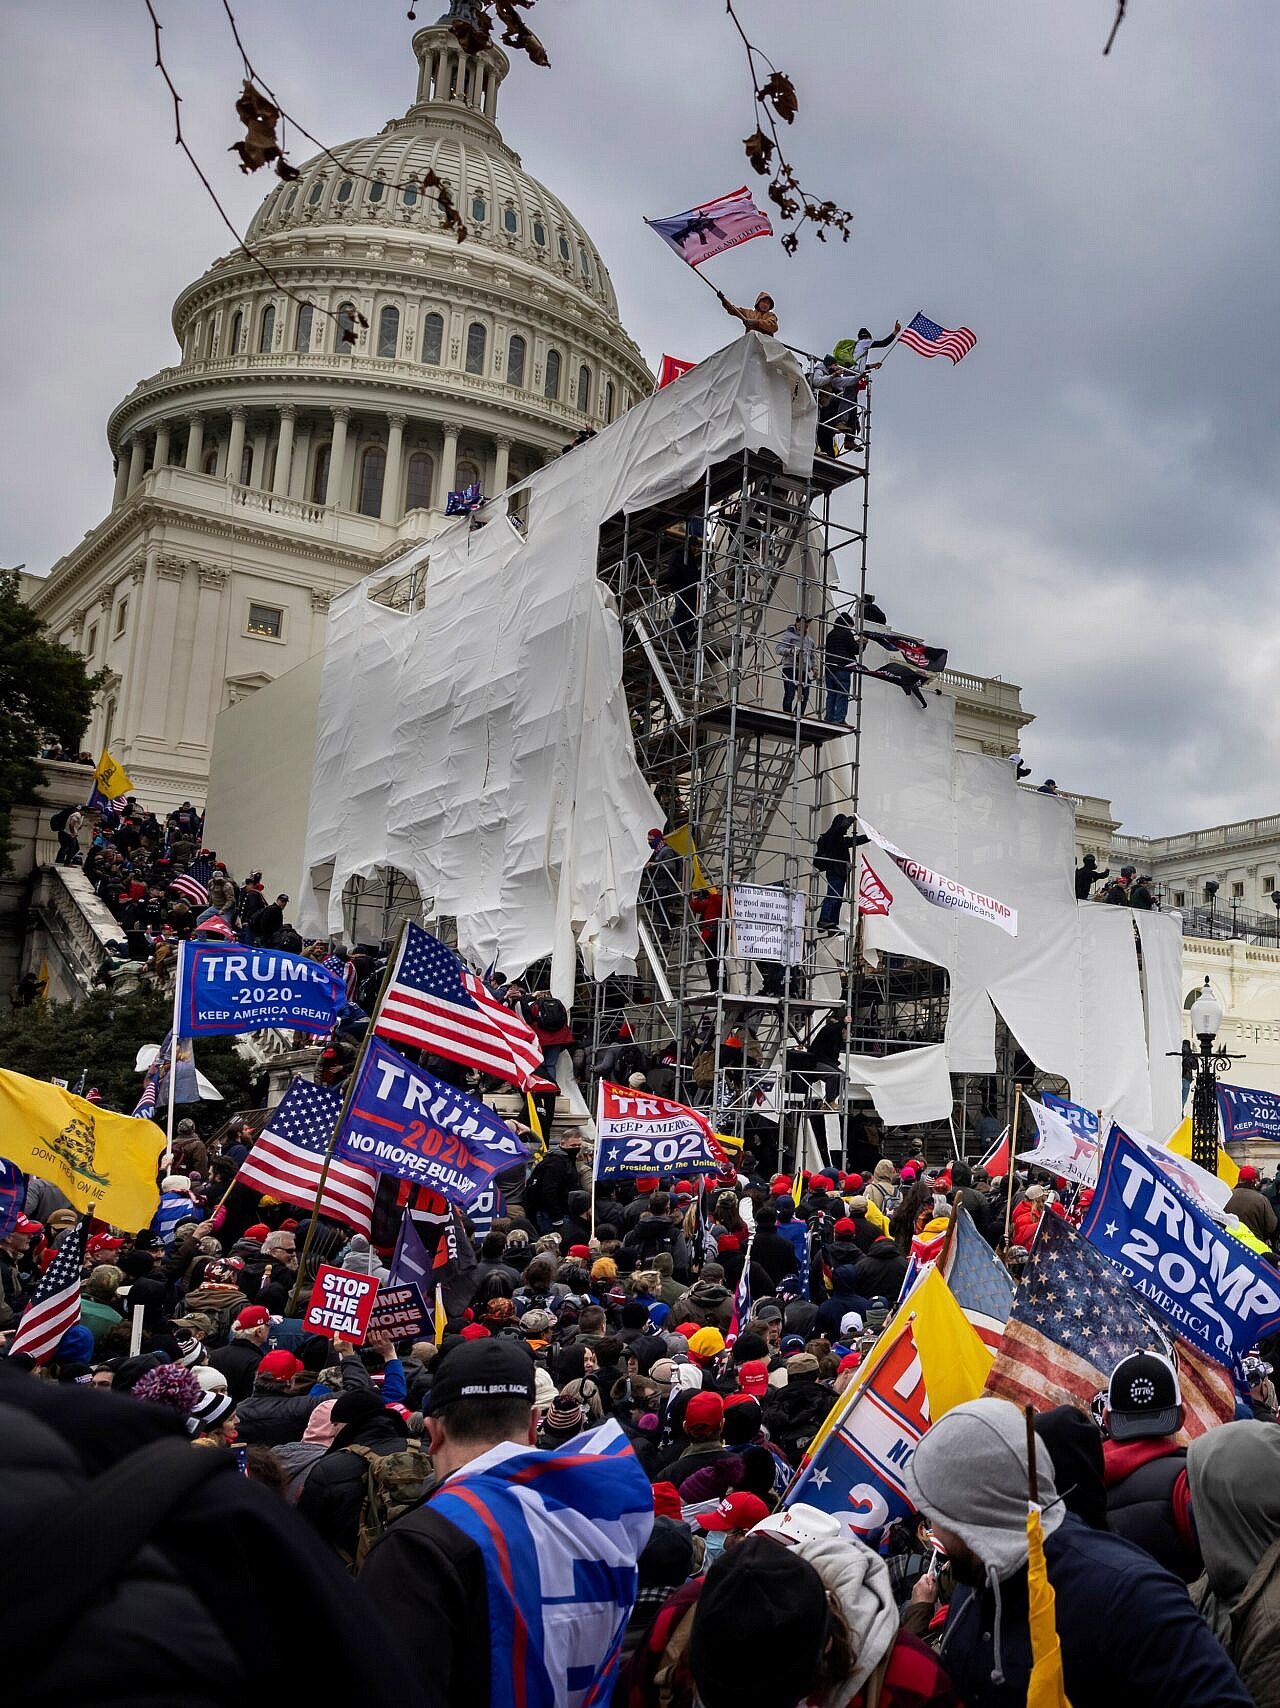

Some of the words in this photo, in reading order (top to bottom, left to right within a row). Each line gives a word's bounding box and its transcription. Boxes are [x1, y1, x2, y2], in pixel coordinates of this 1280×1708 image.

[723, 238, 738, 247] AND
[738, 228, 754, 240] TAKE
[896, 857, 934, 884] FIGHT
[939, 875, 967, 897] FOR
[966, 890, 1011, 919] TRUMP
[744, 900, 758, 908] good
[937, 890, 996, 920] Republicans
[745, 910, 757, 920] they
[759, 911, 770, 919] will
[231, 988, 302, 1004] -2020-
[199, 1010, 230, 1021] KEEP
[233, 1006, 288, 1020] AMERICA
[291, 1007, 331, 1022] GREAT!
[377, 1059, 521, 1155] TRUMP
[612, 1095, 684, 1116] TRU
[610, 1122, 643, 1133] KEEP
[1052, 1105, 1098, 1129] TRU
[1233, 1121, 1253, 1131] KEEP
[348, 1131, 375, 1152] NO
[374, 1141, 429, 1171] MORE
[401, 1119, 471, 1168] 2020
[32, 1147, 56, 1163] DONT
[77, 1180, 91, 1194] ON
[92, 1189, 106, 1201] ME
[620, 1164, 660, 1172] President
[445, 1226, 458, 1259] FOR
[322, 1273, 370, 1297] STOP
[325, 1292, 360, 1315] THE
[374, 1290, 413, 1307] UMP
[368, 1308, 422, 1328] MORE
[1133, 1278, 1210, 1341] AMERICA
[309, 1307, 362, 1336] STEAL
[374, 1323, 420, 1339] ARS
[1135, 1387, 1150, 1395] 1776
